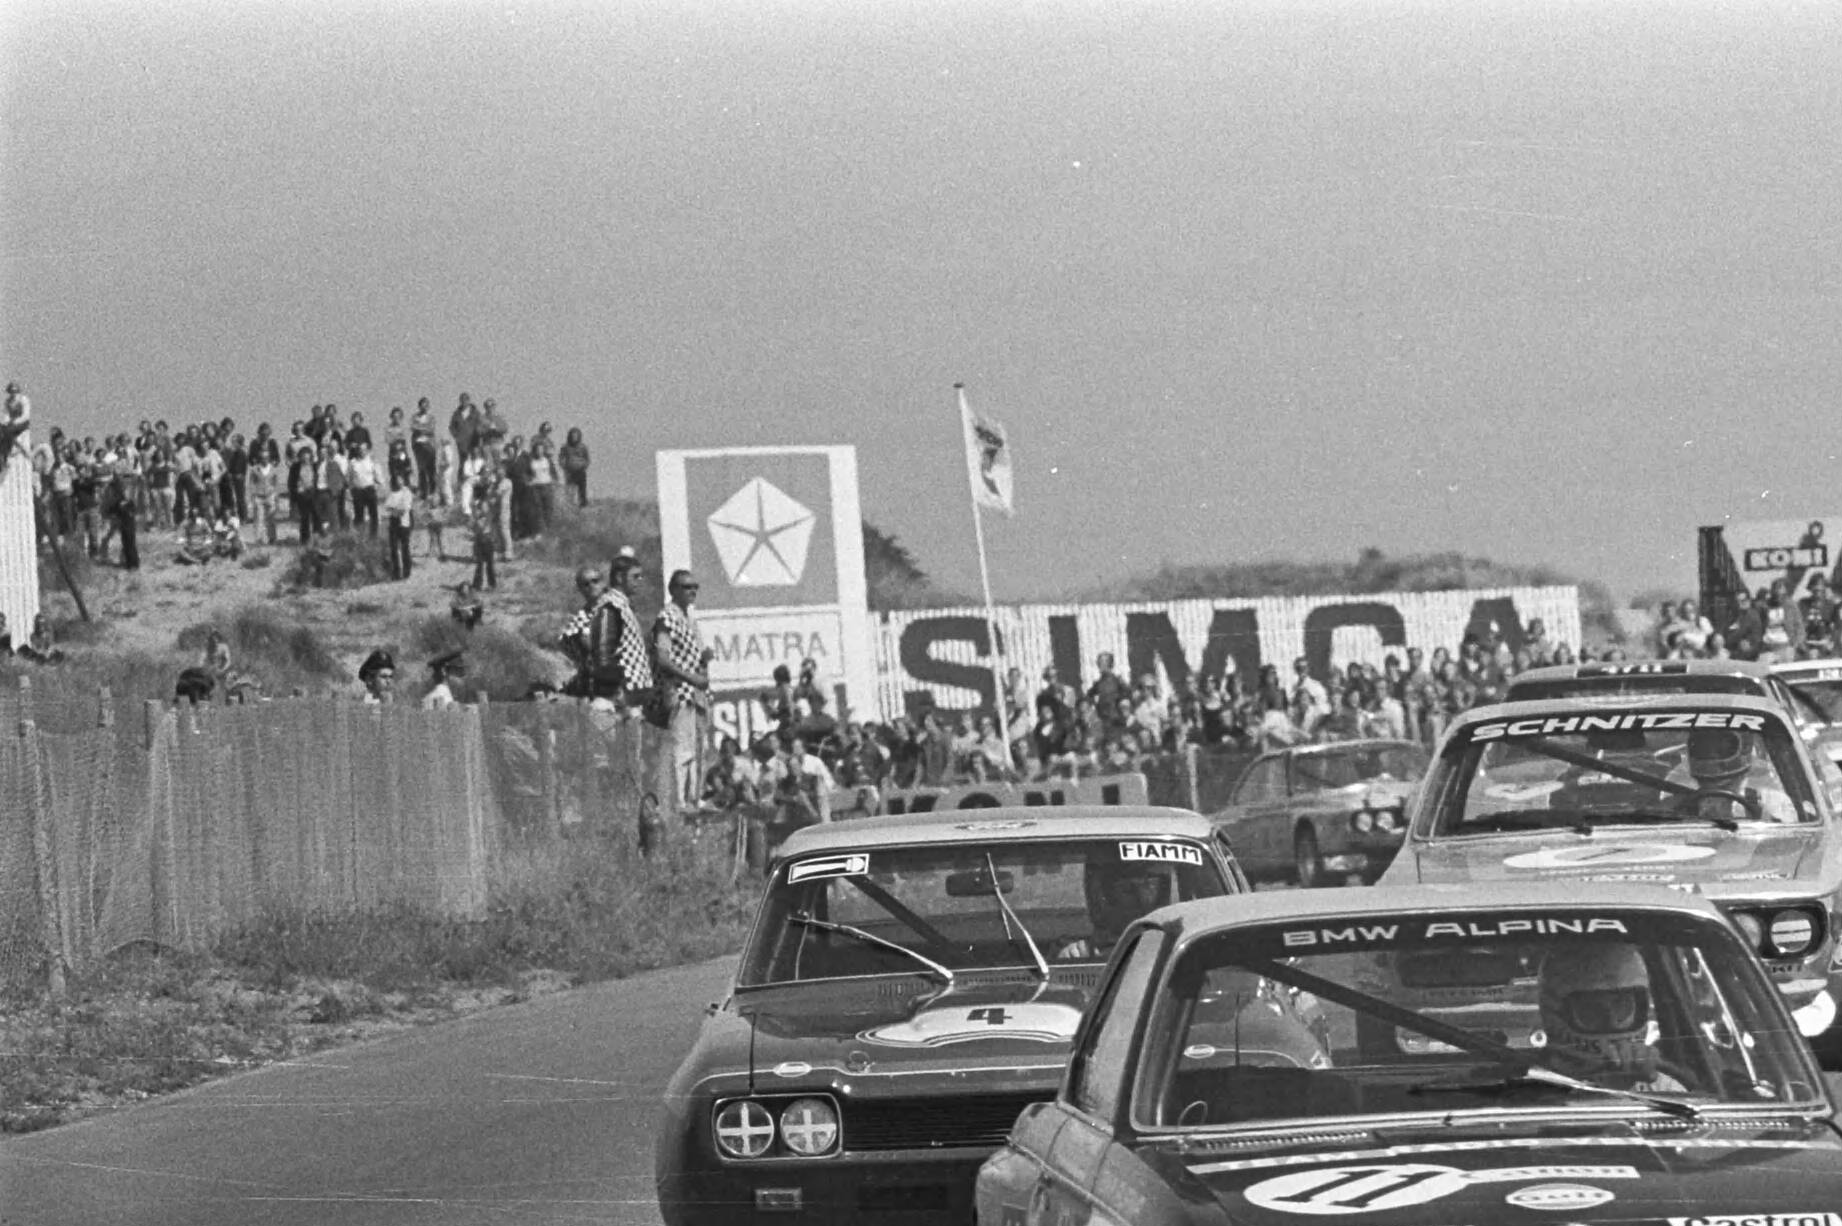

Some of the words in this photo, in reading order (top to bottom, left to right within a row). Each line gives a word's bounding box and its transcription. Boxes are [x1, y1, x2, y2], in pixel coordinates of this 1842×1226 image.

[713, 631, 827, 662] MATRA
[1471, 712, 1766, 742] SCHNITZER
[1121, 843, 1200, 863] FIAMM
[1282, 924, 1400, 946] BMW
[1425, 918, 1629, 938] ALPINA
[966, 1007, 1013, 1025] 4
[1271, 1168, 1448, 1209] 11
